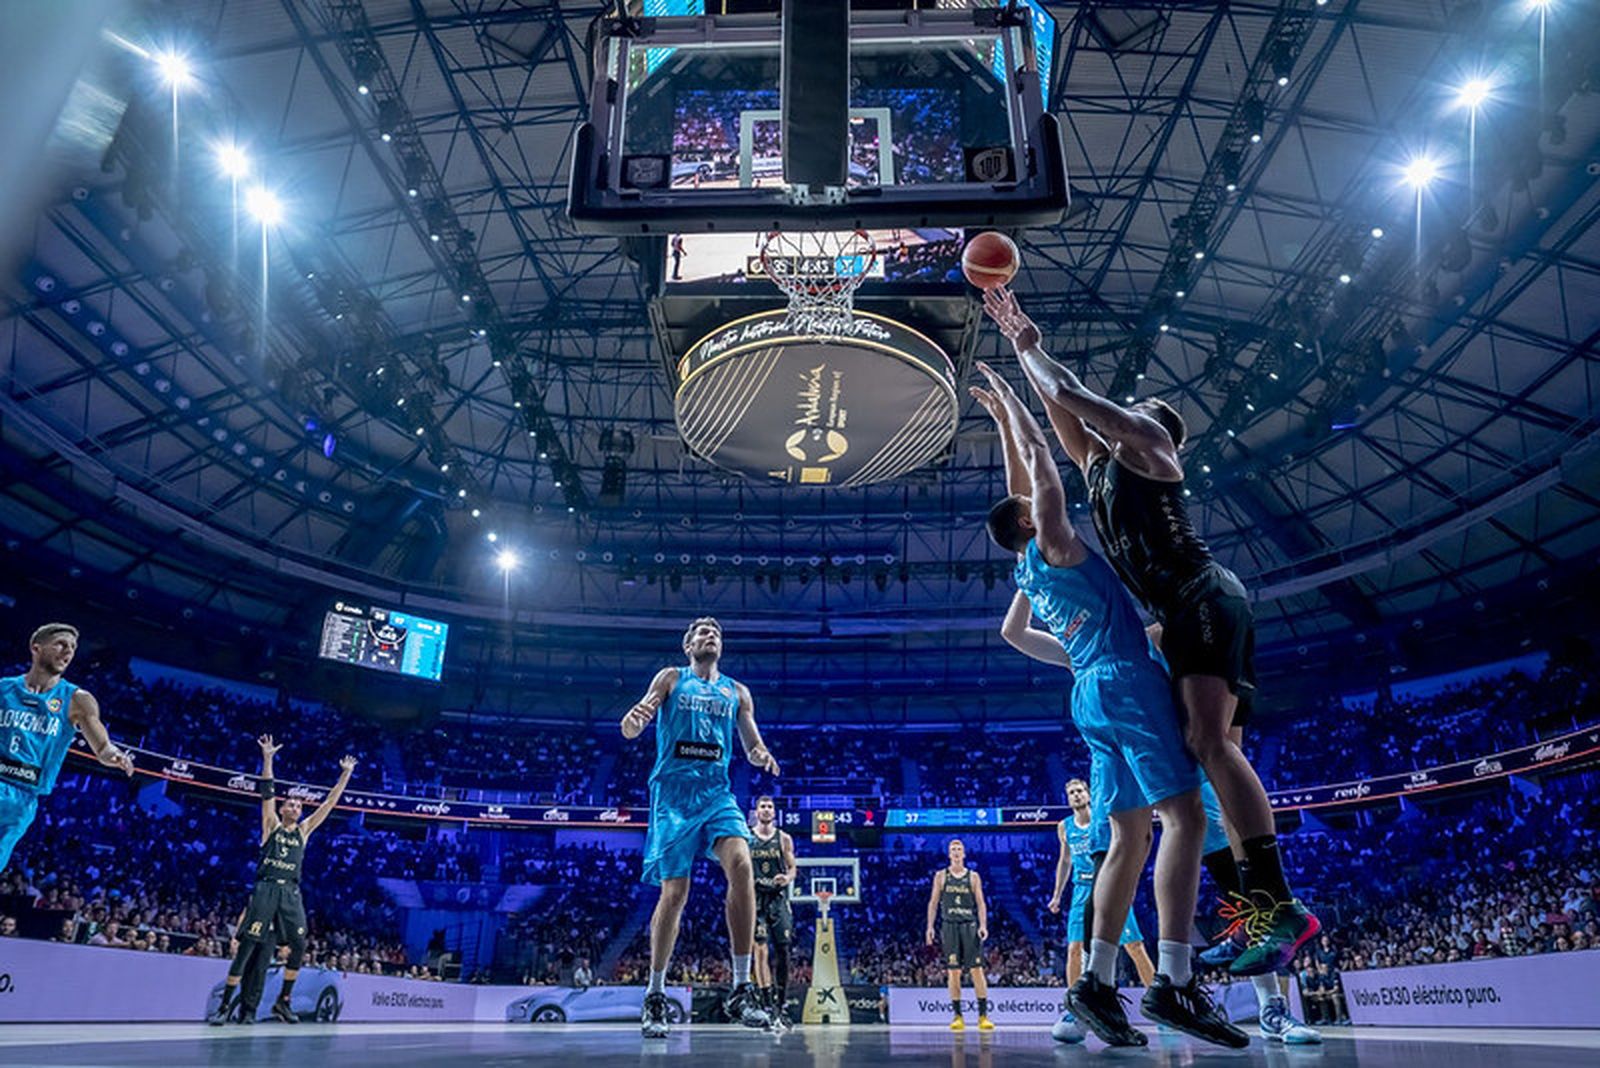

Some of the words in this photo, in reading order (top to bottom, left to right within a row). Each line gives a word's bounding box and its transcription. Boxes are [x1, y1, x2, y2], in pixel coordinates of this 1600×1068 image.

[9, 734, 21, 754] 6
[785, 812, 800, 825] 35
[1353, 989, 1379, 1006] Volvo
[1380, 986, 1411, 1006] EX30
[1413, 984, 1463, 1005] eléctrico
[1466, 986, 1501, 1008] puro.
[961, 1000, 995, 1013] EX0
[997, 999, 1055, 1013] eléctrico
